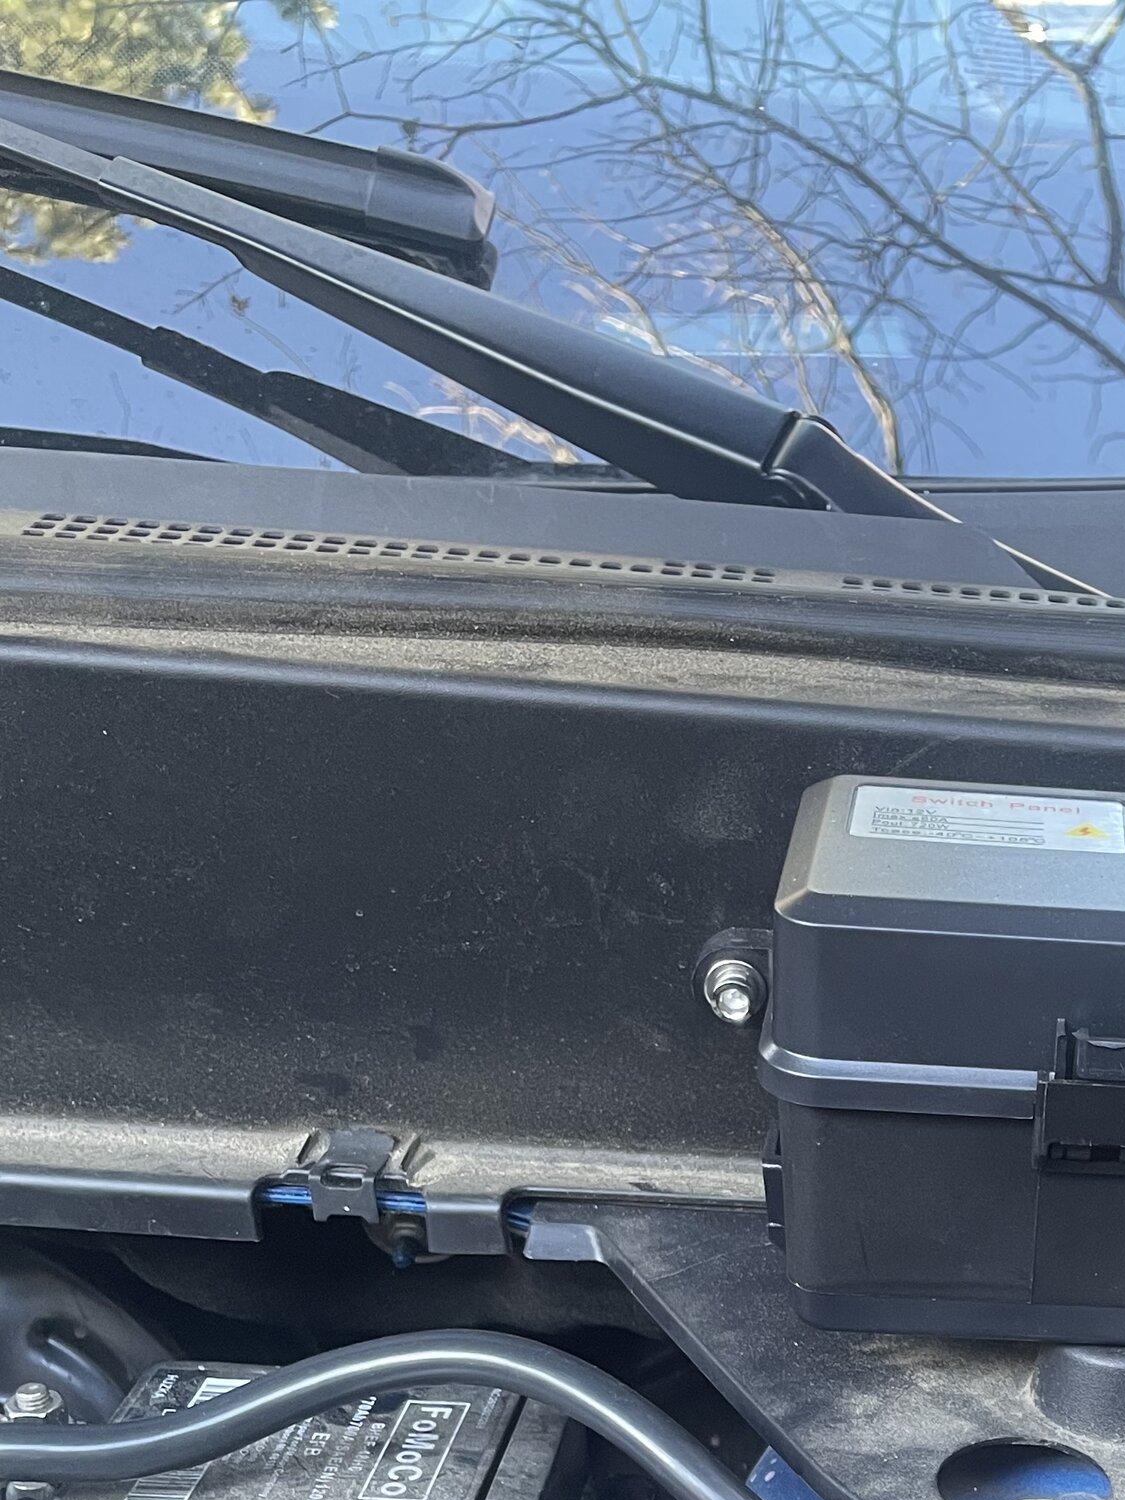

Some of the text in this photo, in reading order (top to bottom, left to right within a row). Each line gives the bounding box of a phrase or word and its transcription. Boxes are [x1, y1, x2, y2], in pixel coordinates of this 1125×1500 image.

[911, 795, 1080, 813] Switch Panel
[302, 1432, 331, 1455] EFB
[378, 1405, 453, 1496] FoMoCo
